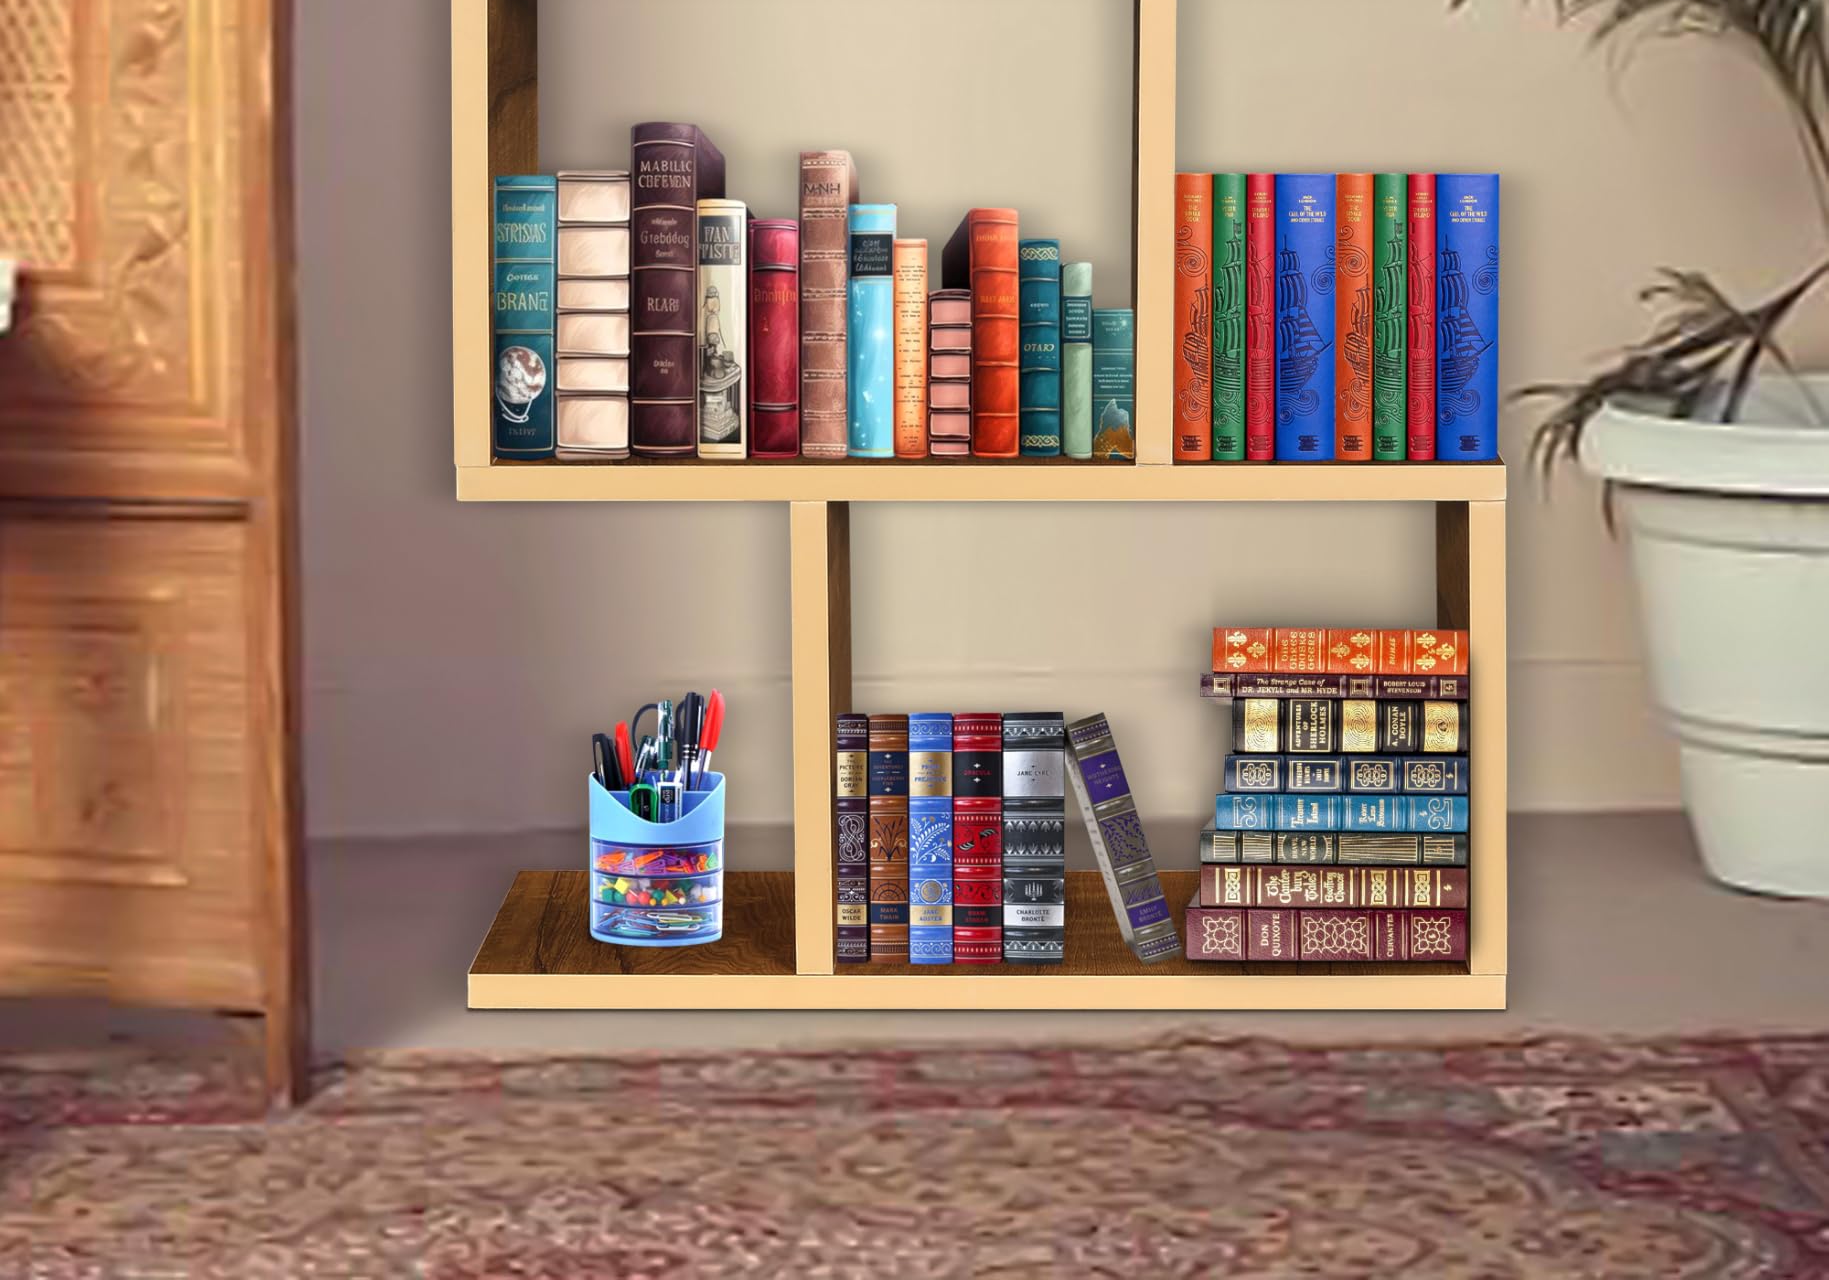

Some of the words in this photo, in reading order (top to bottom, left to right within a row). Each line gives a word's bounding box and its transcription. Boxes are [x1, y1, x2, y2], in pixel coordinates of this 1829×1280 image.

[1271, 678, 1297, 687] Strange
[1316, 678, 1326, 687] of
[1303, 721, 1309, 731] OF
[1310, 701, 1318, 749] SHERLOCK
[1392, 738, 1399, 747] A.
[1265, 875, 1278, 898] The
[1290, 870, 1309, 892] bury
[1303, 873, 1319, 902] Tales
[1261, 924, 1269, 946] DON
[1272, 913, 1281, 956] QUIXOTE
